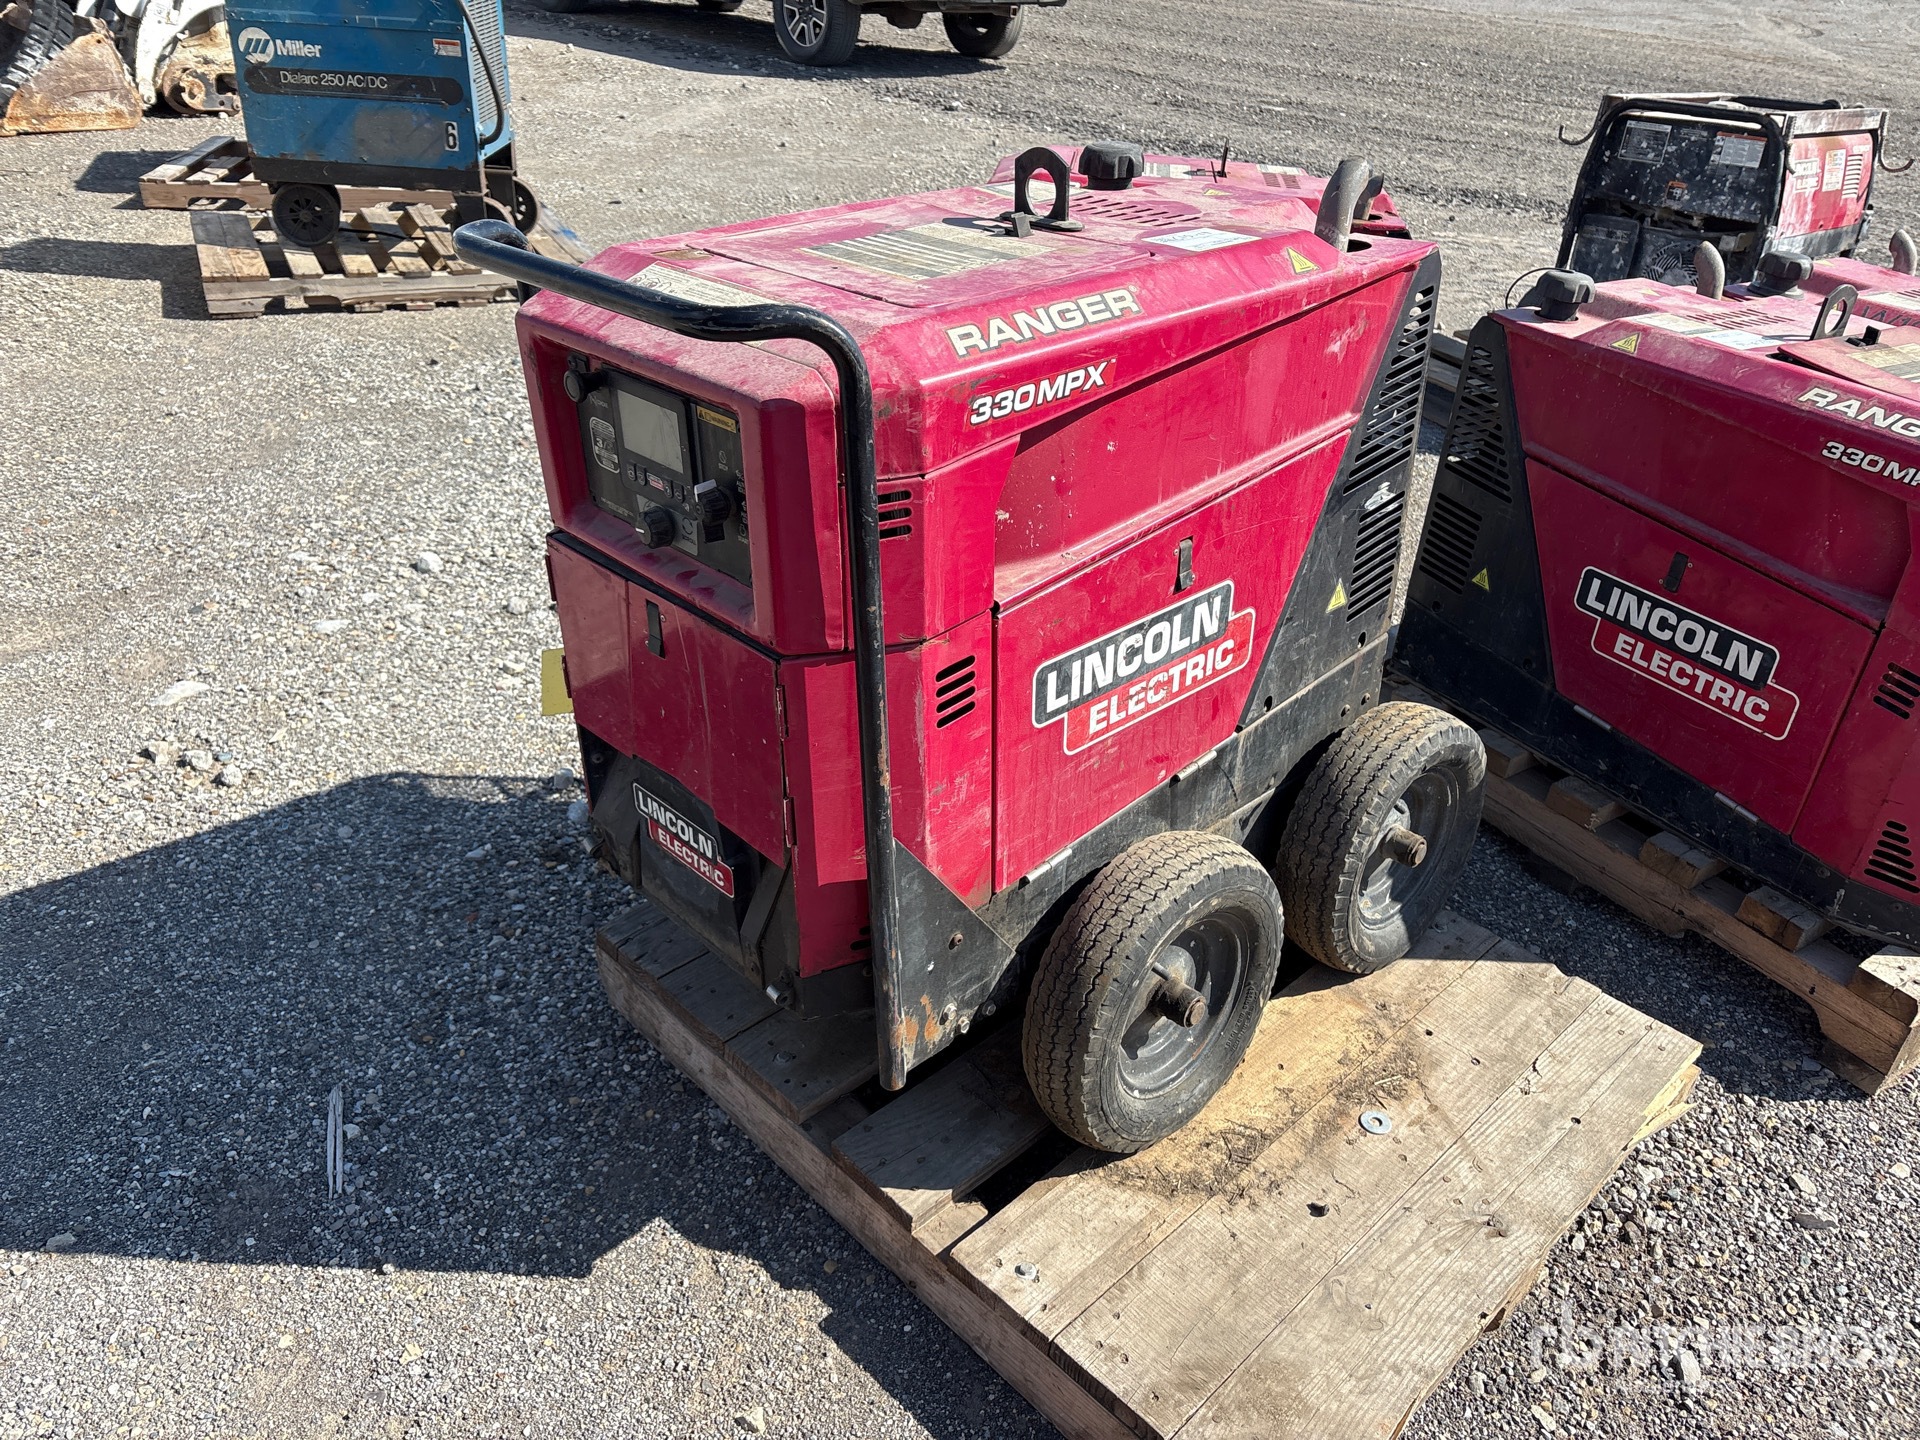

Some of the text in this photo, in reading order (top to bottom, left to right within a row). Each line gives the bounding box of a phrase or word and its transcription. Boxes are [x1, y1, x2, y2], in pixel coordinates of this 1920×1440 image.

[275, 37, 322, 59] Miller
[280, 70, 388, 90] Dialarc 250 AC/DC
[444, 122, 457, 150] 6
[947, 288, 1142, 357] RANGER
[1046, 595, 1222, 713] LINCOLN
[1585, 577, 1764, 682] LINCOLN
[1089, 638, 1235, 735] ELECTRIC
[1613, 632, 1770, 723] ELECTRIC
[638, 790, 713, 860] LINCOLN
[657, 827, 725, 887] ELECTRIC
